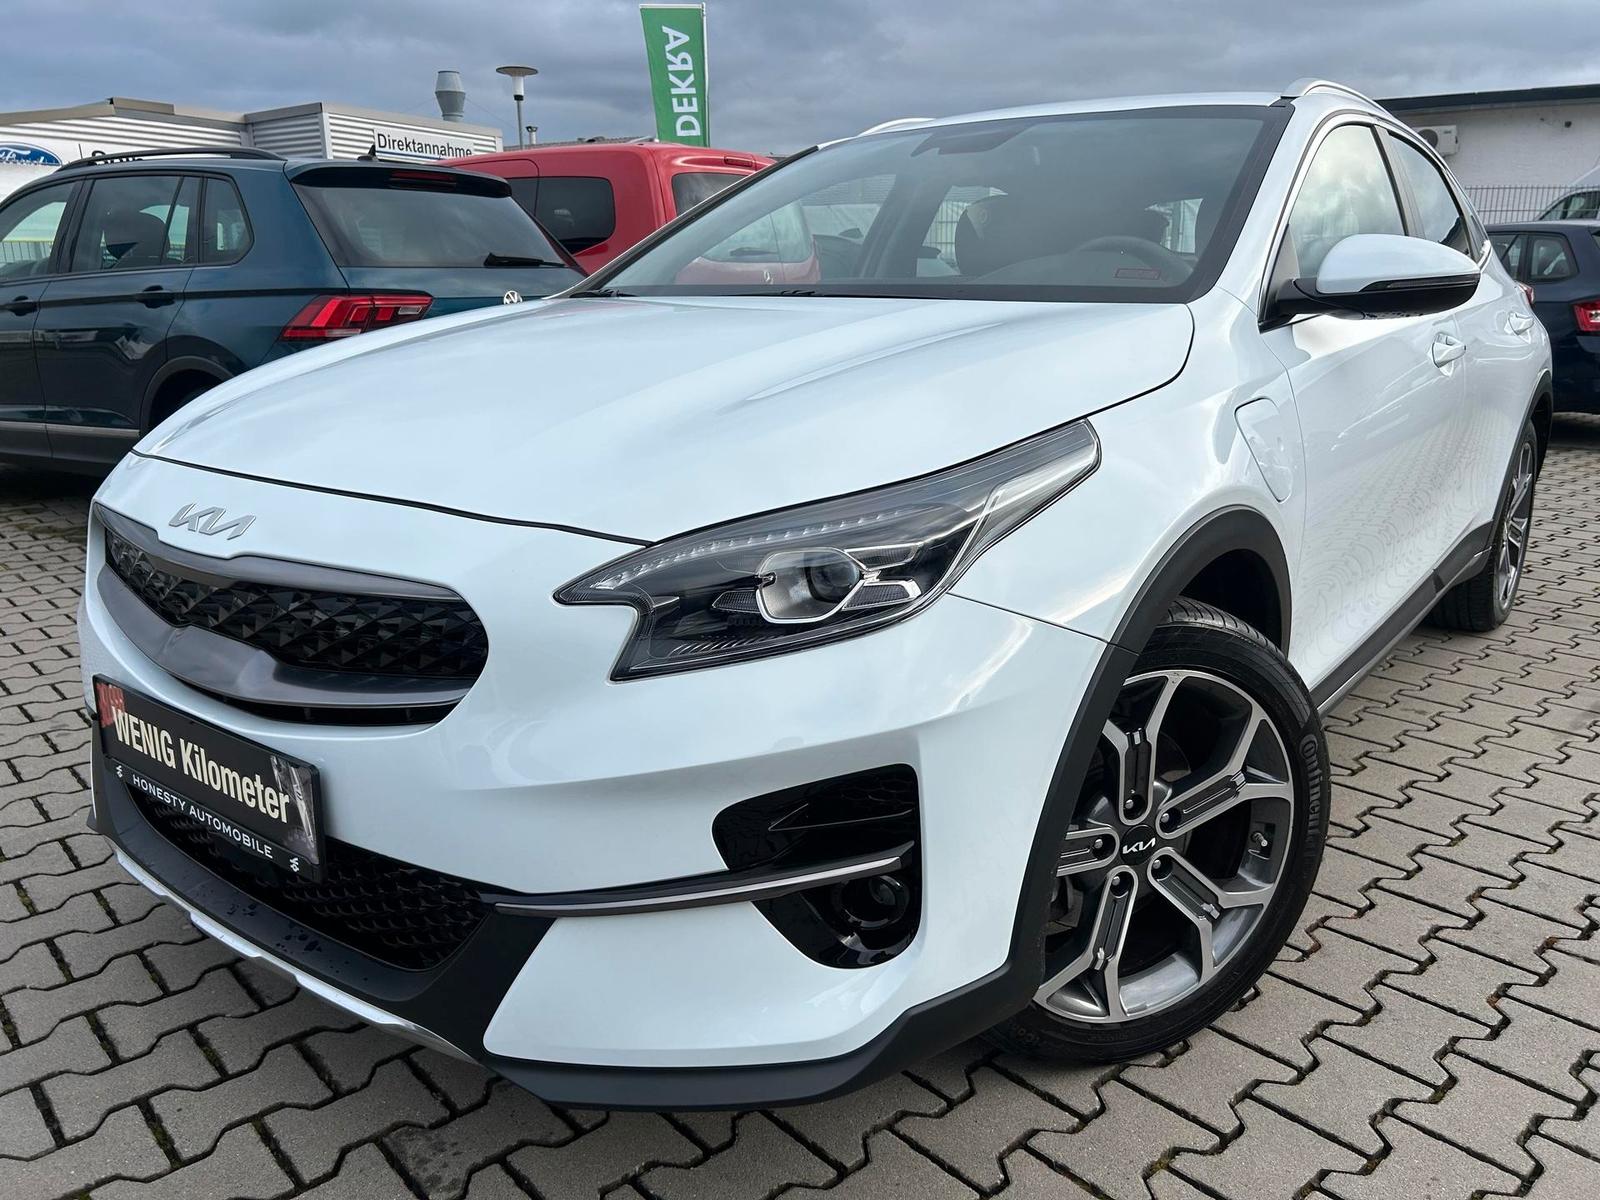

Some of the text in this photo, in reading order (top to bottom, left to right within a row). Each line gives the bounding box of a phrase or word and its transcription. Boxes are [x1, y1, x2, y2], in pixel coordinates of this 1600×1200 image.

[377, 133, 472, 158] Direktannahme
[168, 502, 257, 541] KIA
[111, 705, 290, 824] WENIG Kilometer
[132, 773, 274, 859] HONESTY AUTOMOBILE
[1122, 837, 1156, 855] KIA
